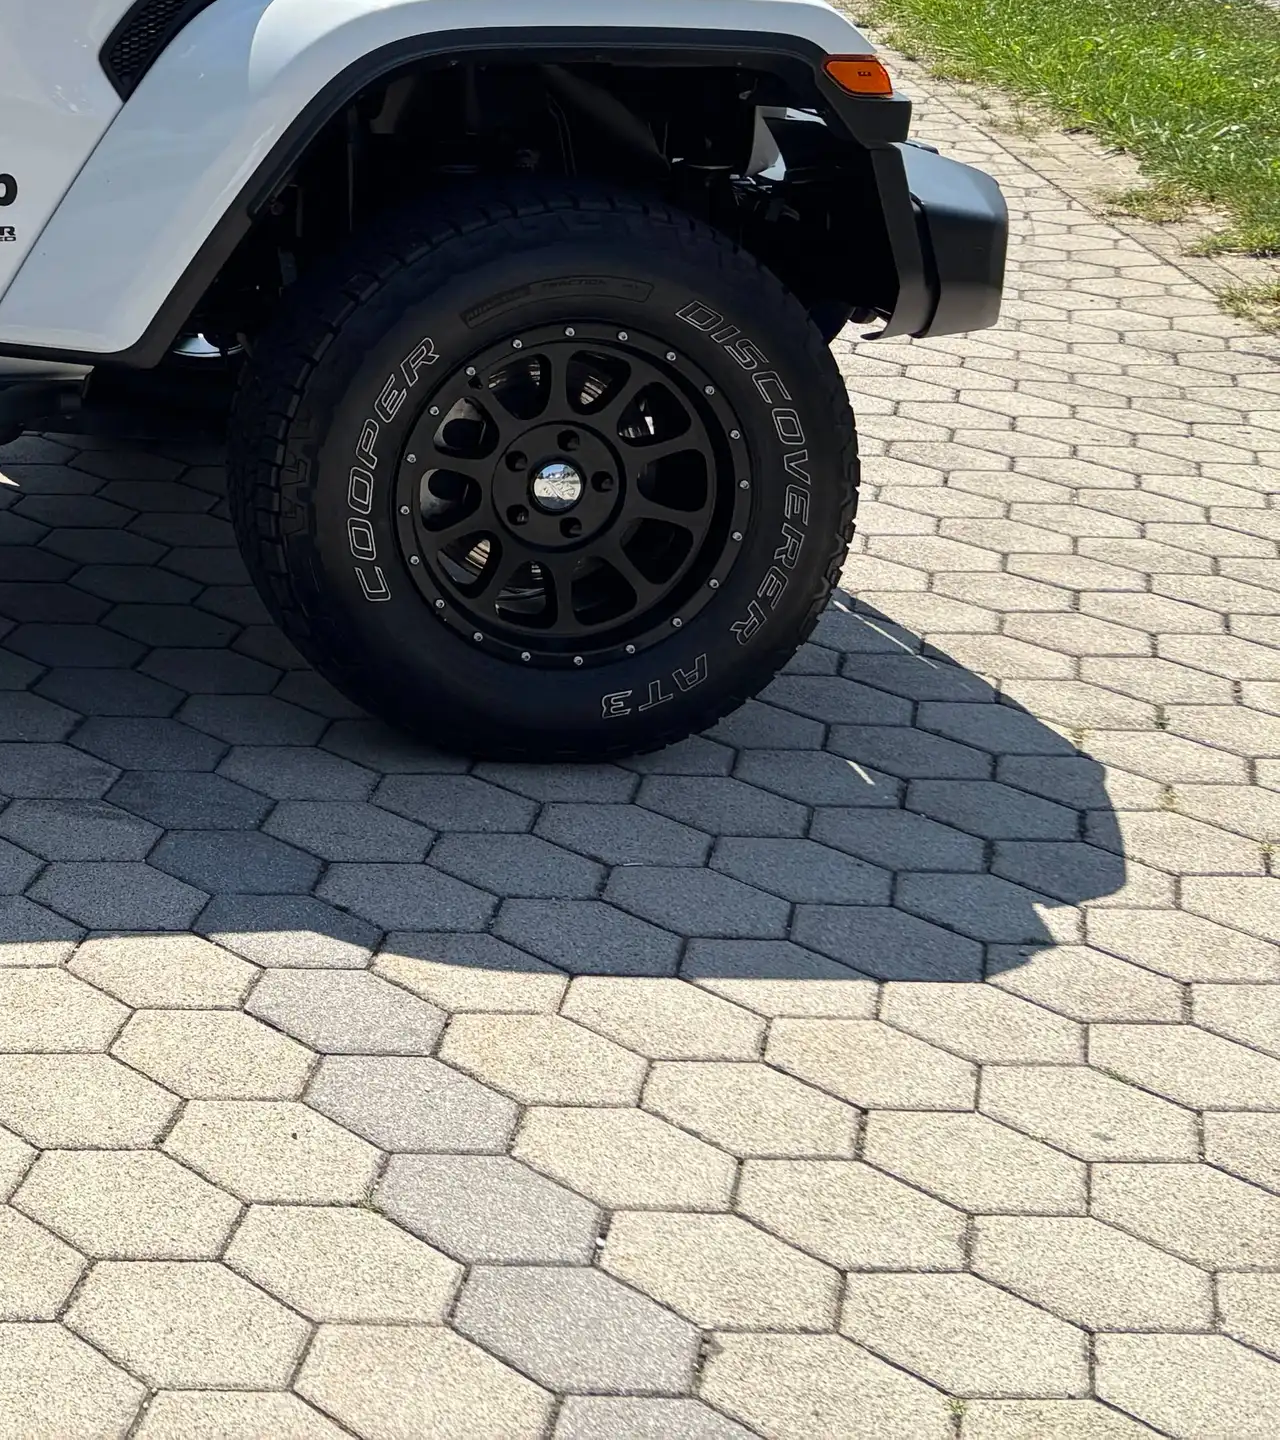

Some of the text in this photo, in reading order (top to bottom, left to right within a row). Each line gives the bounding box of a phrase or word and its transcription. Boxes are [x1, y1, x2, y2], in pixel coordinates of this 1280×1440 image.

[346, 336, 440, 603] COOPER
[600, 299, 813, 720] DISCOVERER AT3
